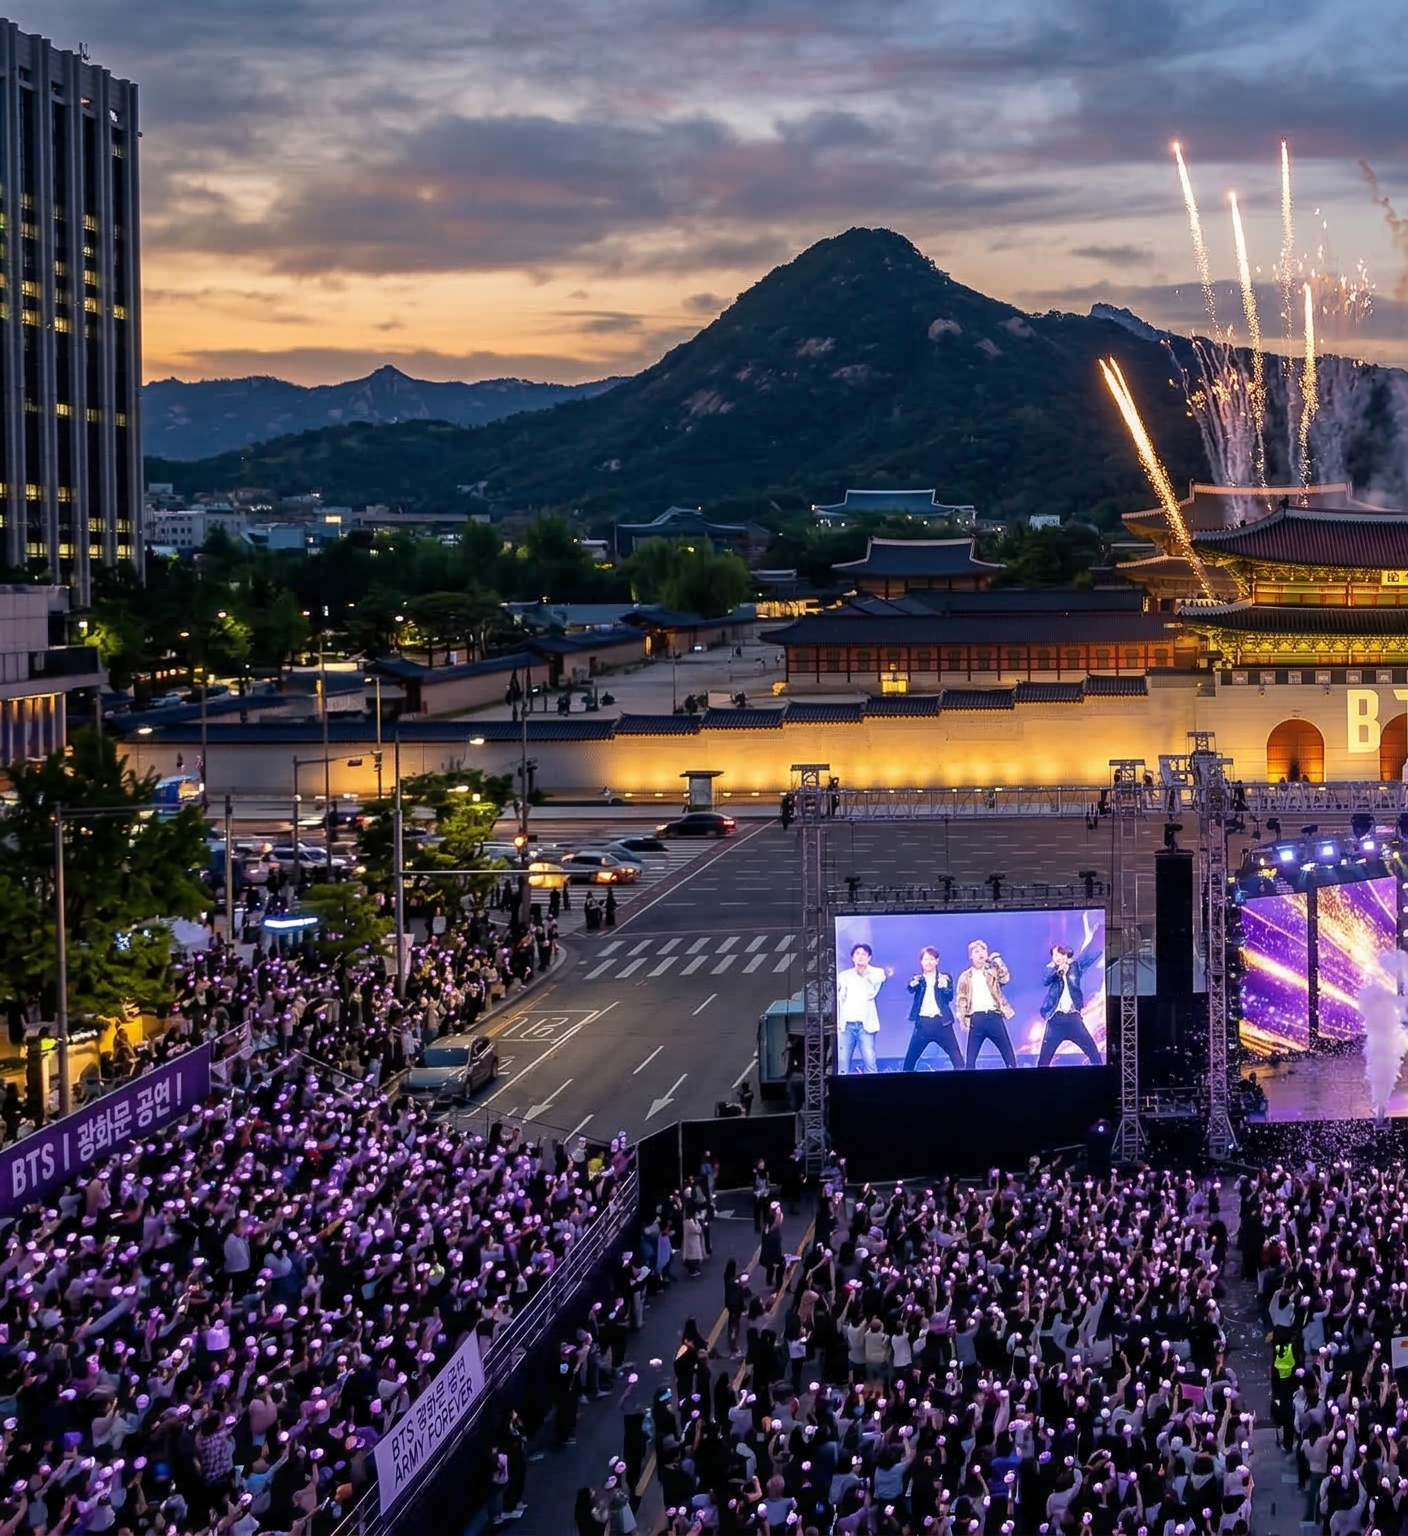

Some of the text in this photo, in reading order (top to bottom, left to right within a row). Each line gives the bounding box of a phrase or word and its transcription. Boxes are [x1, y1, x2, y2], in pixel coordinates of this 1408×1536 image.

[12, 1142, 55, 1199] BTS
[77, 1100, 132, 1162] 광화문
[391, 1419, 415, 1463] BTS
[394, 1377, 474, 1490] ARMY FOREVER
